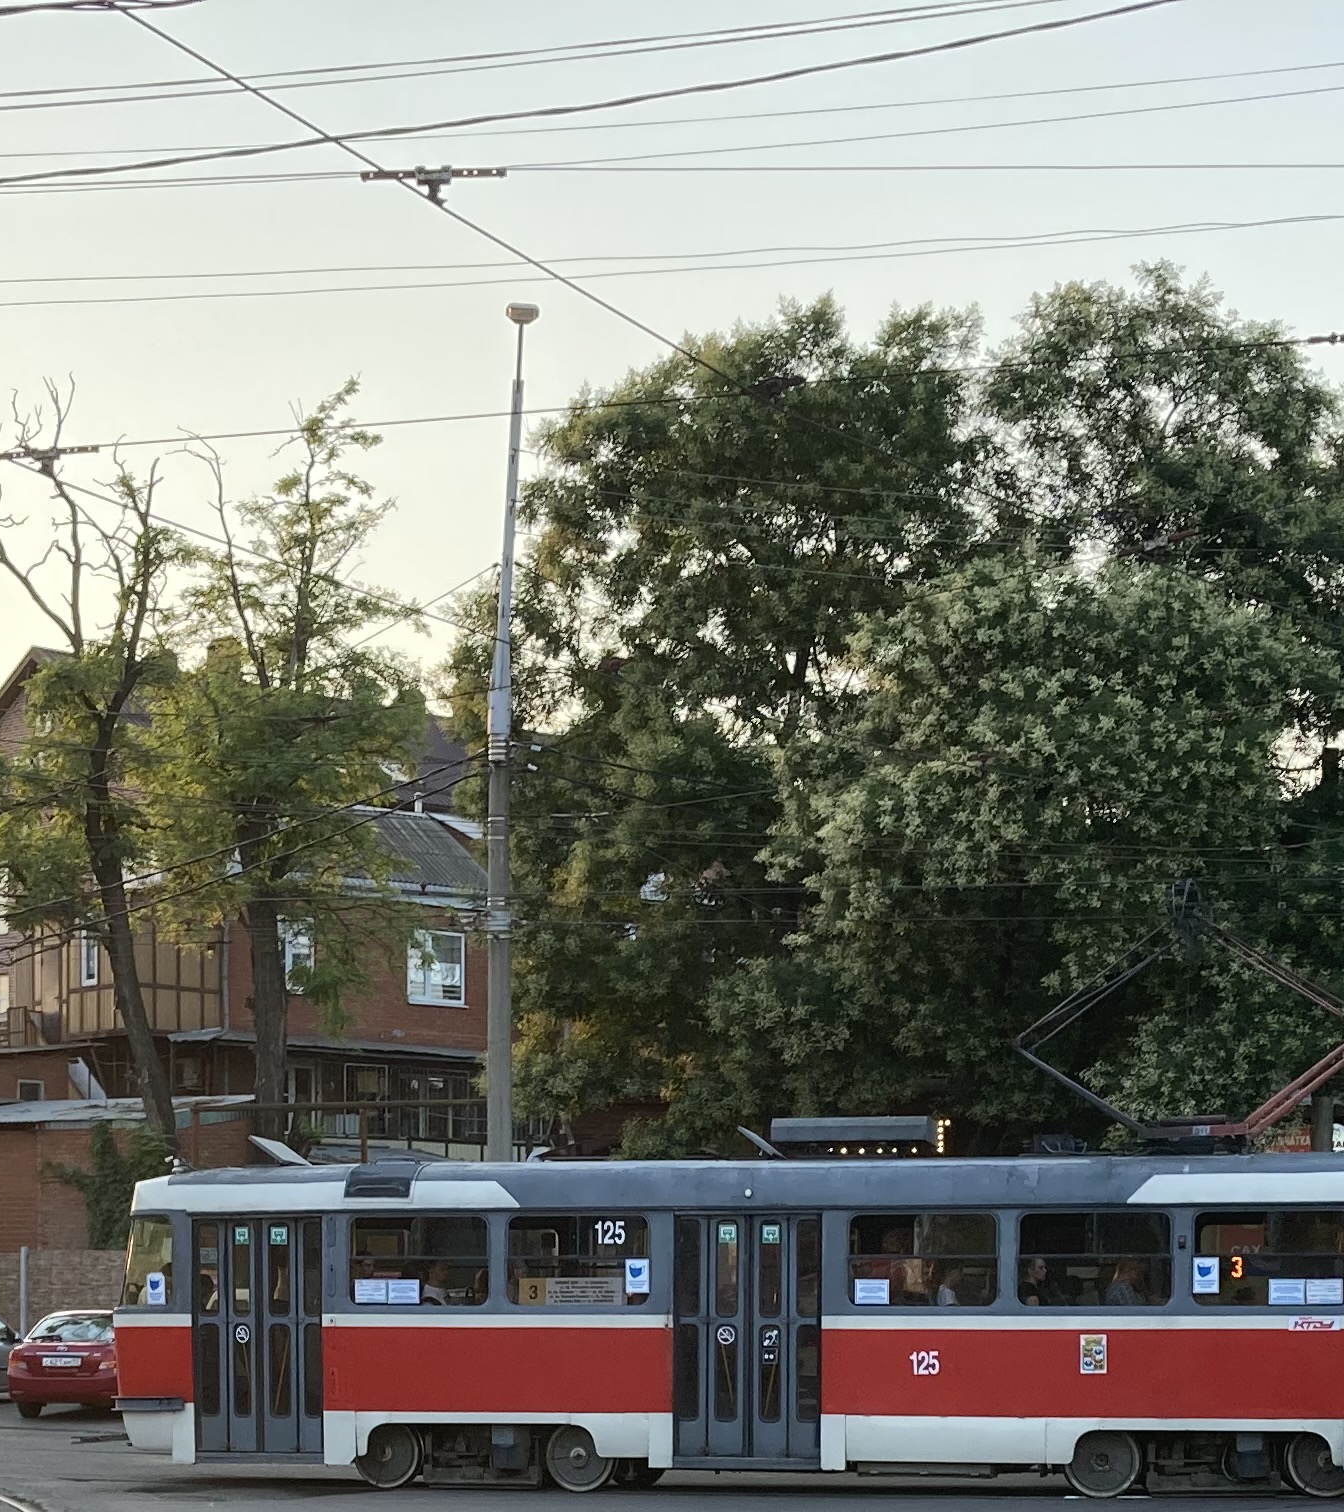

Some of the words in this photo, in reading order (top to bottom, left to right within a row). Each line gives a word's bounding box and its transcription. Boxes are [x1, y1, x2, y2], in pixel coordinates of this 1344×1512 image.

[594, 1220, 626, 1245] 125
[1230, 1256, 1243, 1278] 3
[528, 1285, 539, 1300] 3
[909, 1350, 940, 1376] 125
